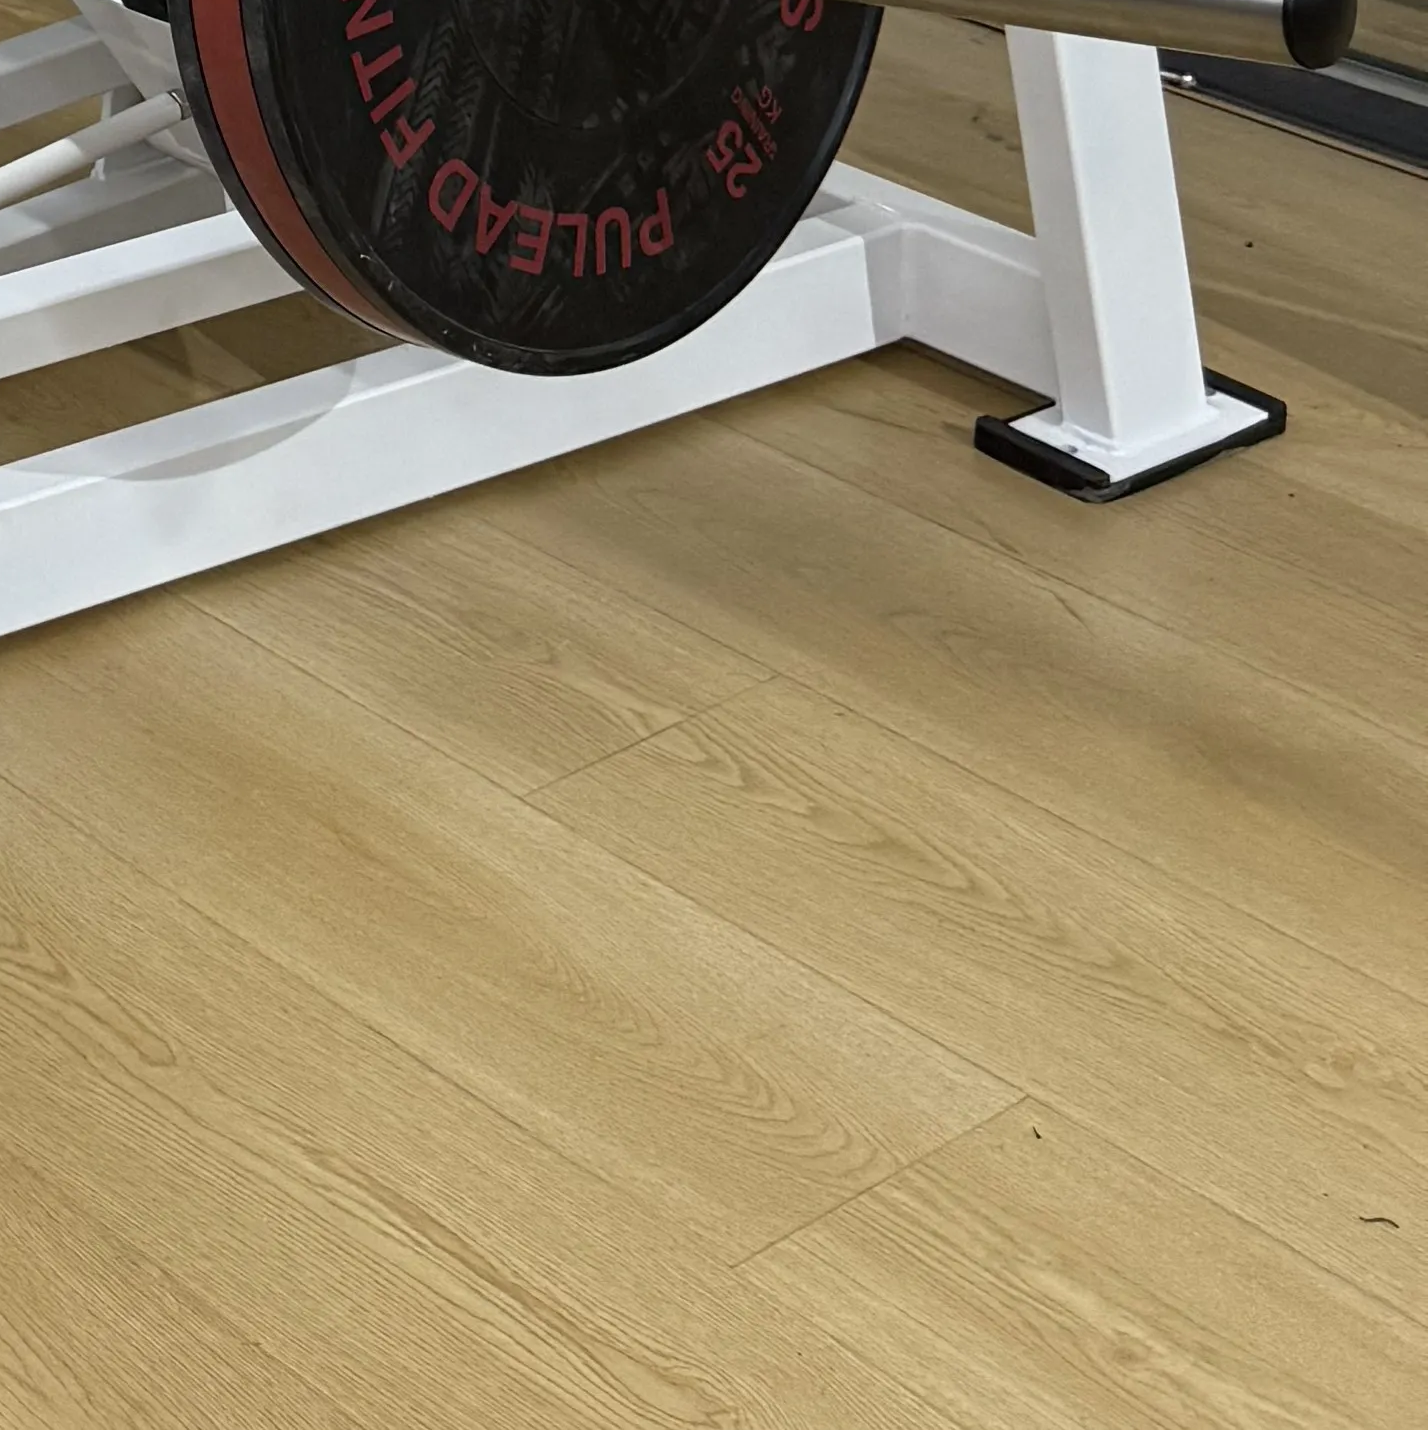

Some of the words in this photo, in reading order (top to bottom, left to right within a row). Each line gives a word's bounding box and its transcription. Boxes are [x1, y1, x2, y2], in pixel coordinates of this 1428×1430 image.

[755, 84, 782, 125] KG
[706, 120, 763, 198] 25
[427, 158, 675, 278] PULEAD
